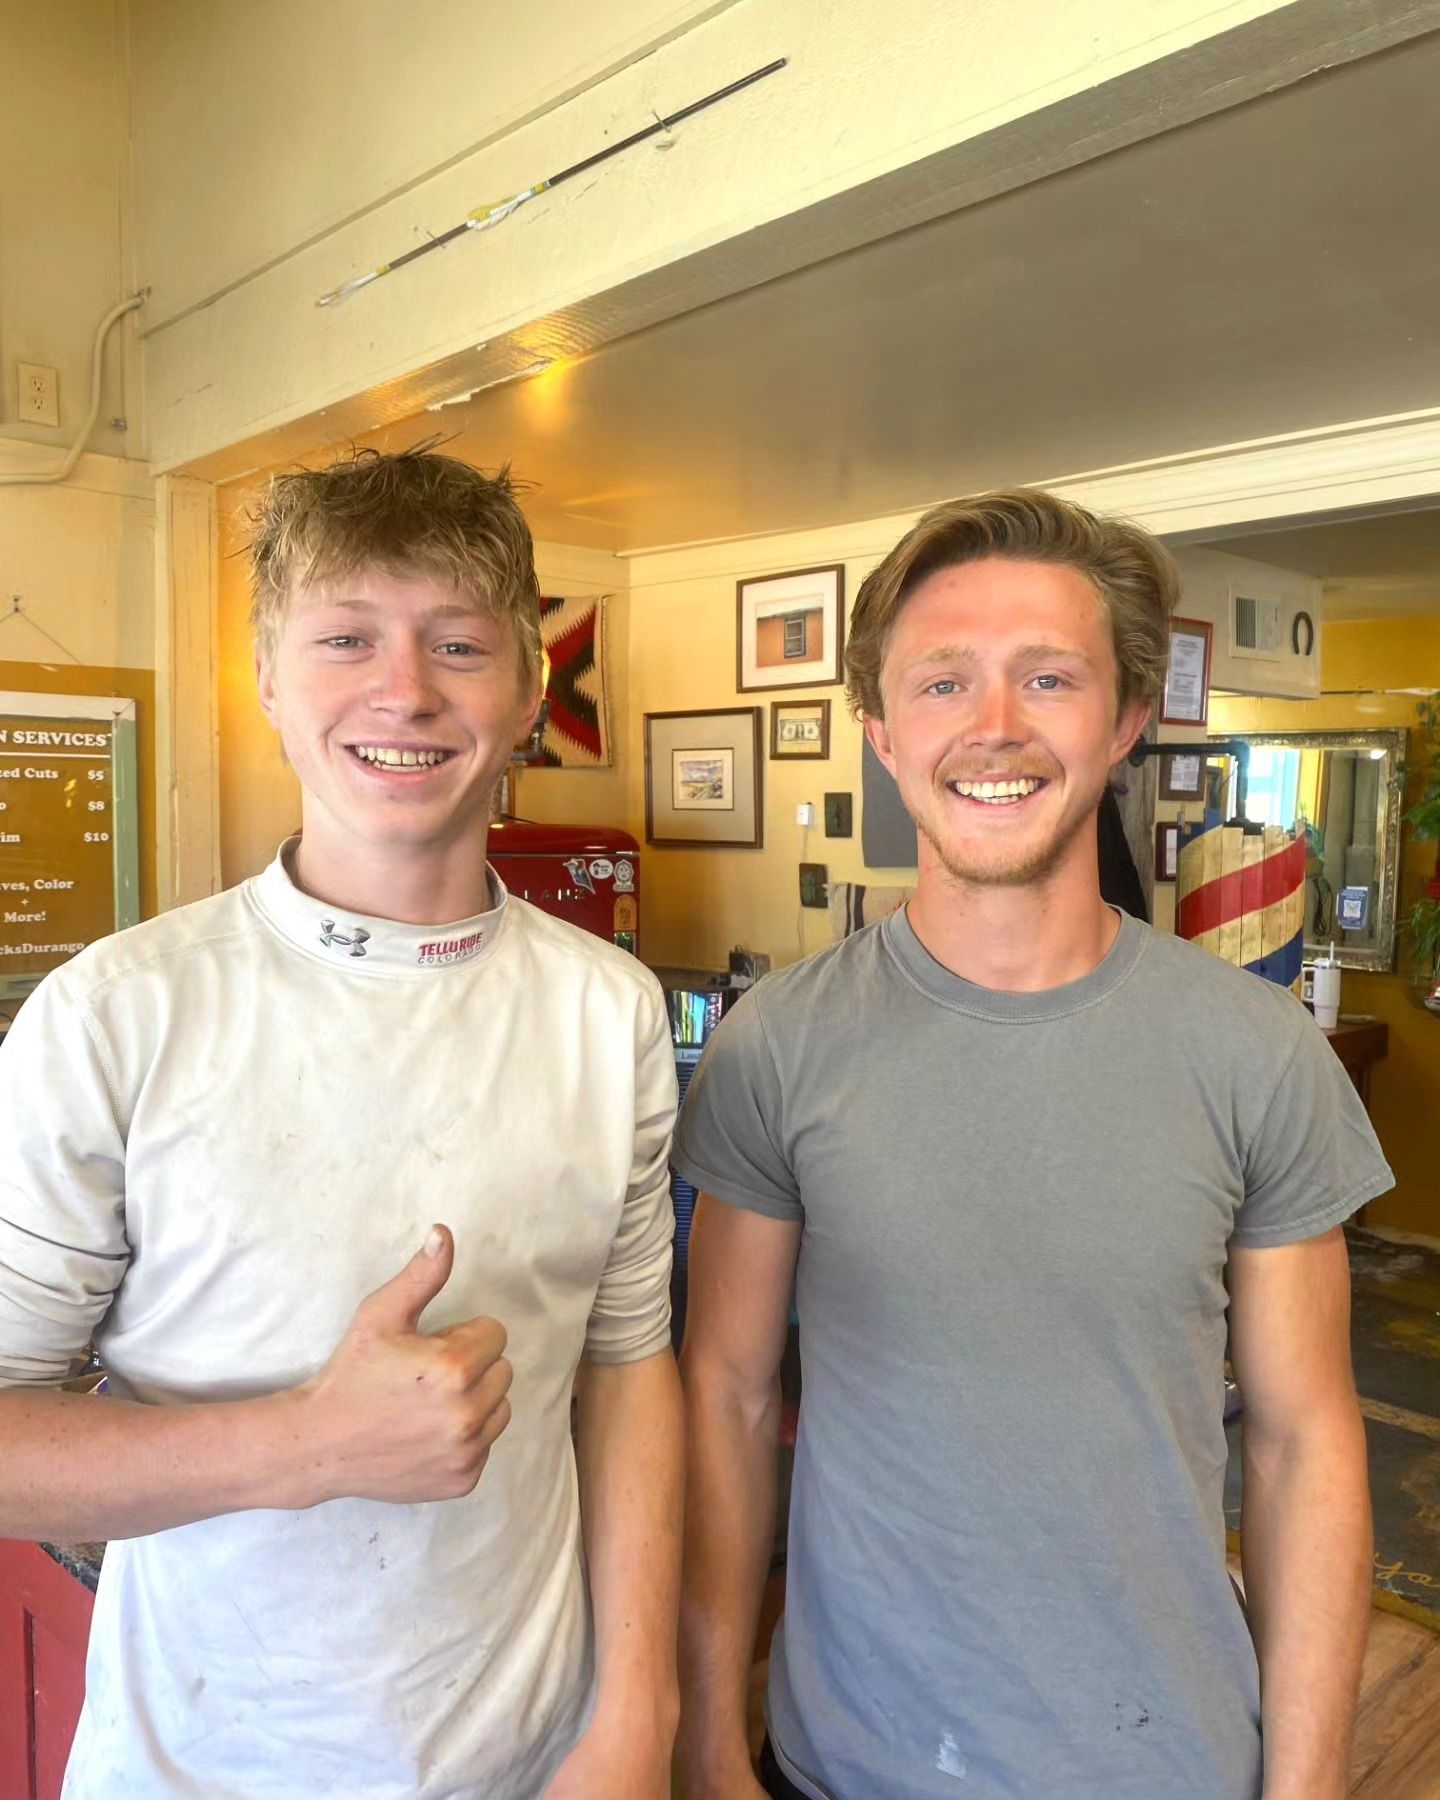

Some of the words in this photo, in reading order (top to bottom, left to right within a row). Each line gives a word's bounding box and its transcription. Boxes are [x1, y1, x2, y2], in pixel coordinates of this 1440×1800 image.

[12, 731, 106, 747] SERVICES
[24, 768, 58, 779] Cuts
[88, 770, 104, 781] $5
[88, 801, 105, 811] $8
[0, 832, 20, 843] im
[84, 832, 109, 843] $10
[0, 882, 30, 892] ves,
[33, 879, 74, 890] Color
[4, 911, 47, 923] More!
[419, 932, 483, 957] TELLURIDE
